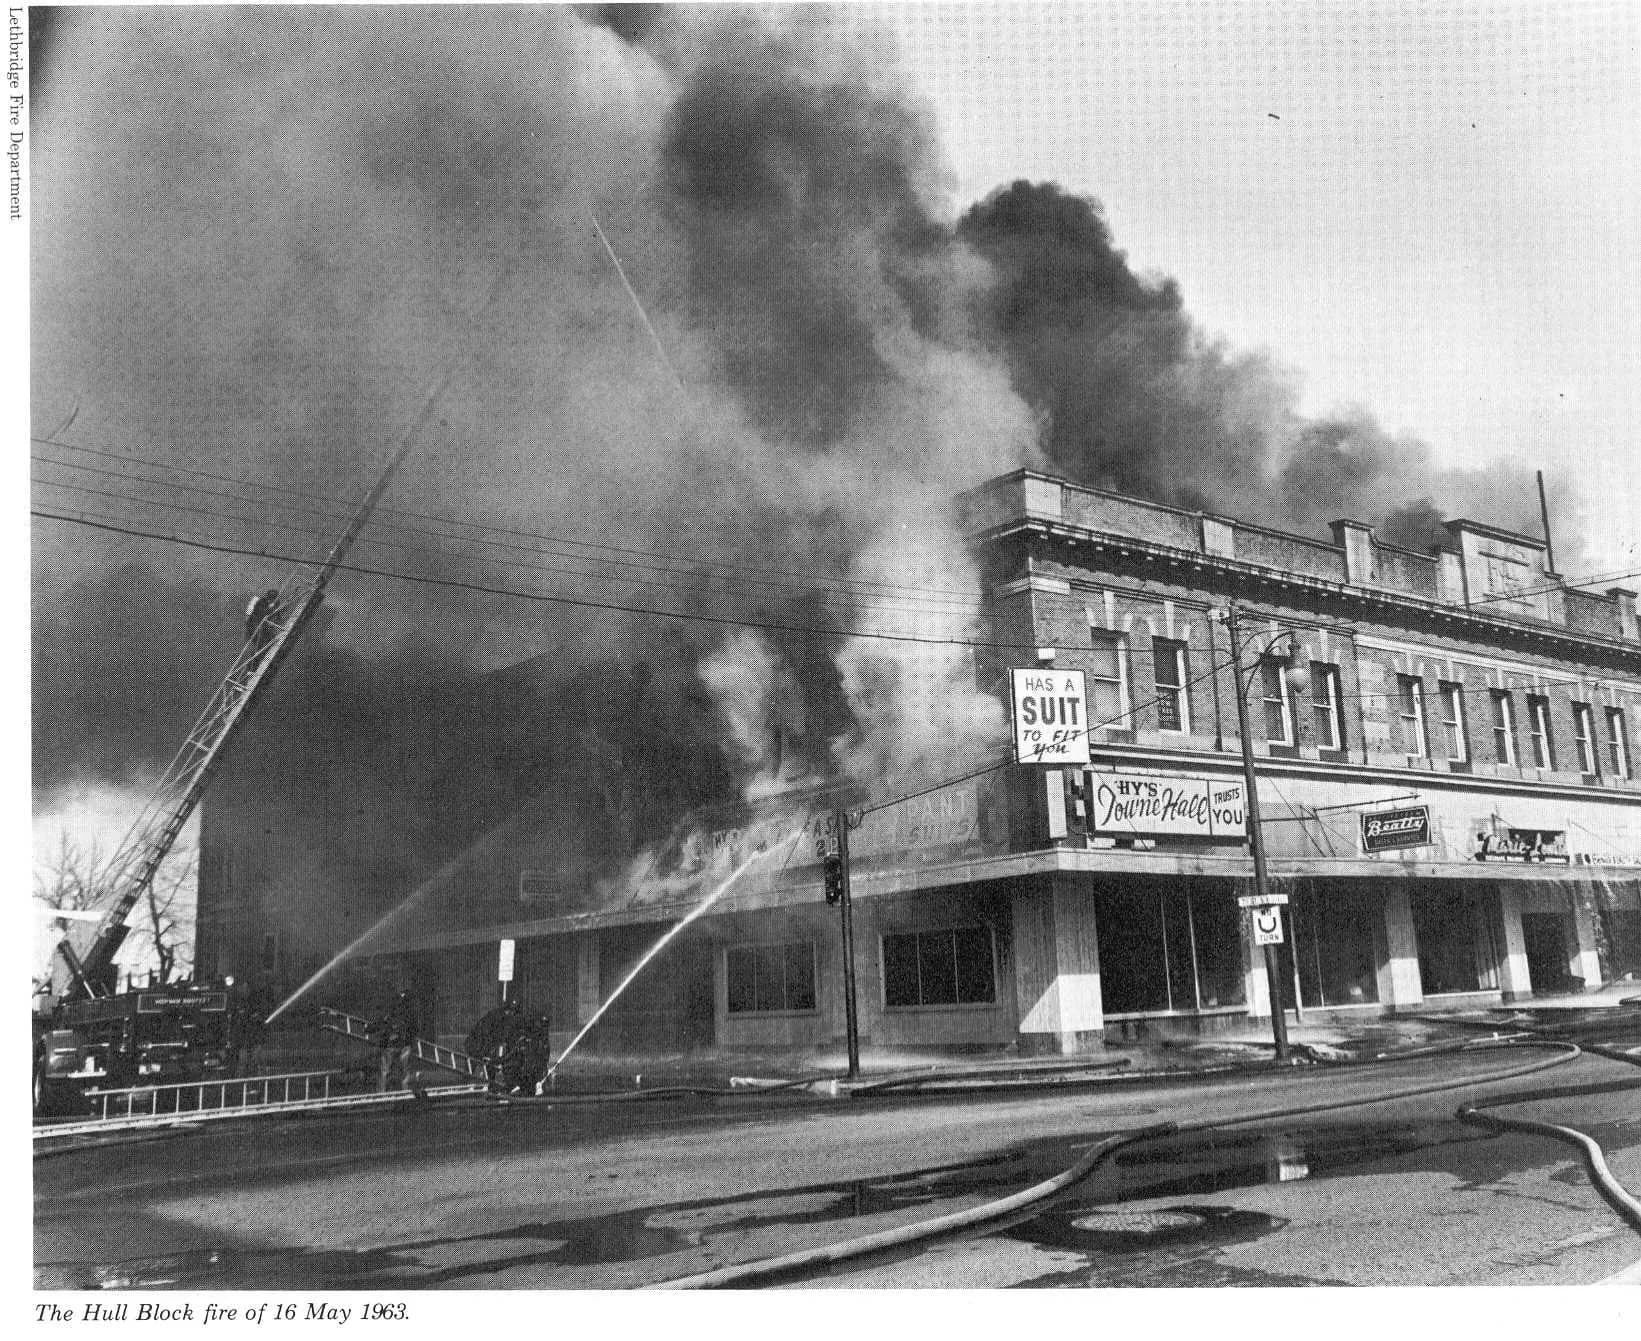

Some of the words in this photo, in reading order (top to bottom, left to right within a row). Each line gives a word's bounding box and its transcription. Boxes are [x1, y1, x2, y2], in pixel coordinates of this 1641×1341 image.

[1025, 677, 1054, 692] HAS
[1065, 678, 1075, 692] A
[1022, 696, 1080, 726] SUIT
[1023, 729, 1042, 742] TO
[1052, 729, 1082, 742] FIT
[1214, 787, 1240, 804] TRUSTS
[1097, 784, 1161, 826] Towne
[1161, 787, 1208, 825] Hall
[1212, 808, 1243, 825] YOU
[1367, 814, 1425, 838] Beatty
[1259, 933, 1280, 942] TURN
